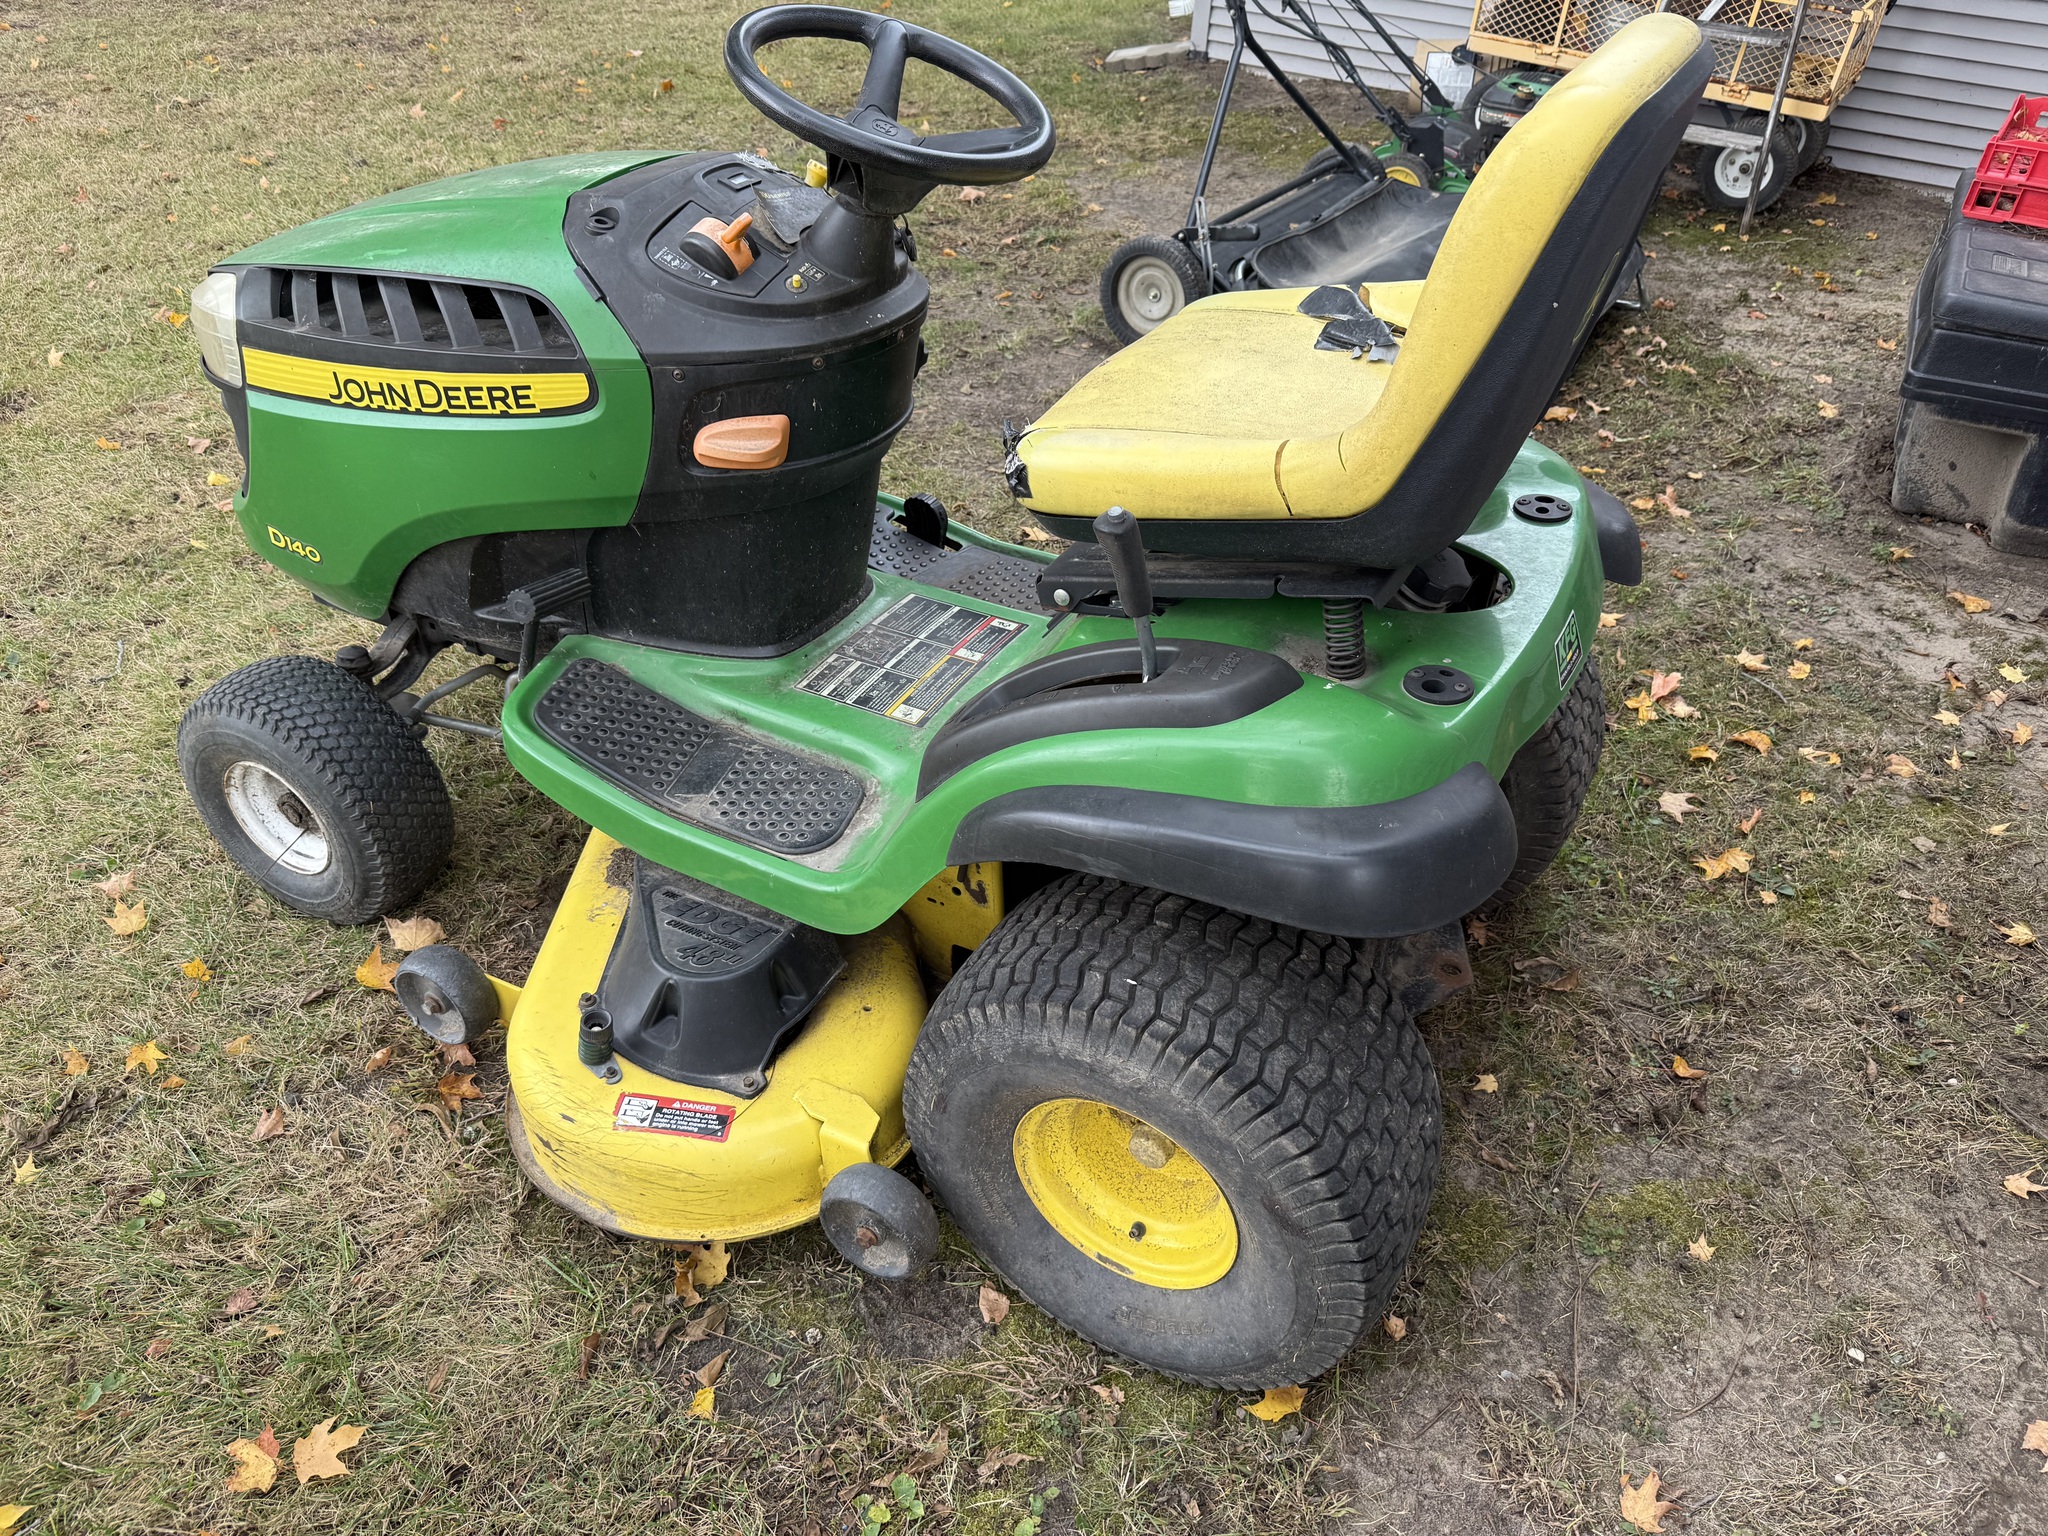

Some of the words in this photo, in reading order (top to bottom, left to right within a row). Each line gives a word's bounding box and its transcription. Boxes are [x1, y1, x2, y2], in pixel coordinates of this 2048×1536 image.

[329, 371, 412, 408] JOHN
[413, 379, 536, 409] DEERE
[267, 525, 321, 562] D140
[661, 897, 773, 944] EDGE
[662, 1108, 695, 1117] ROTATING
[695, 1112, 718, 1120] BLADE
[682, 1102, 717, 1112] DANGER
